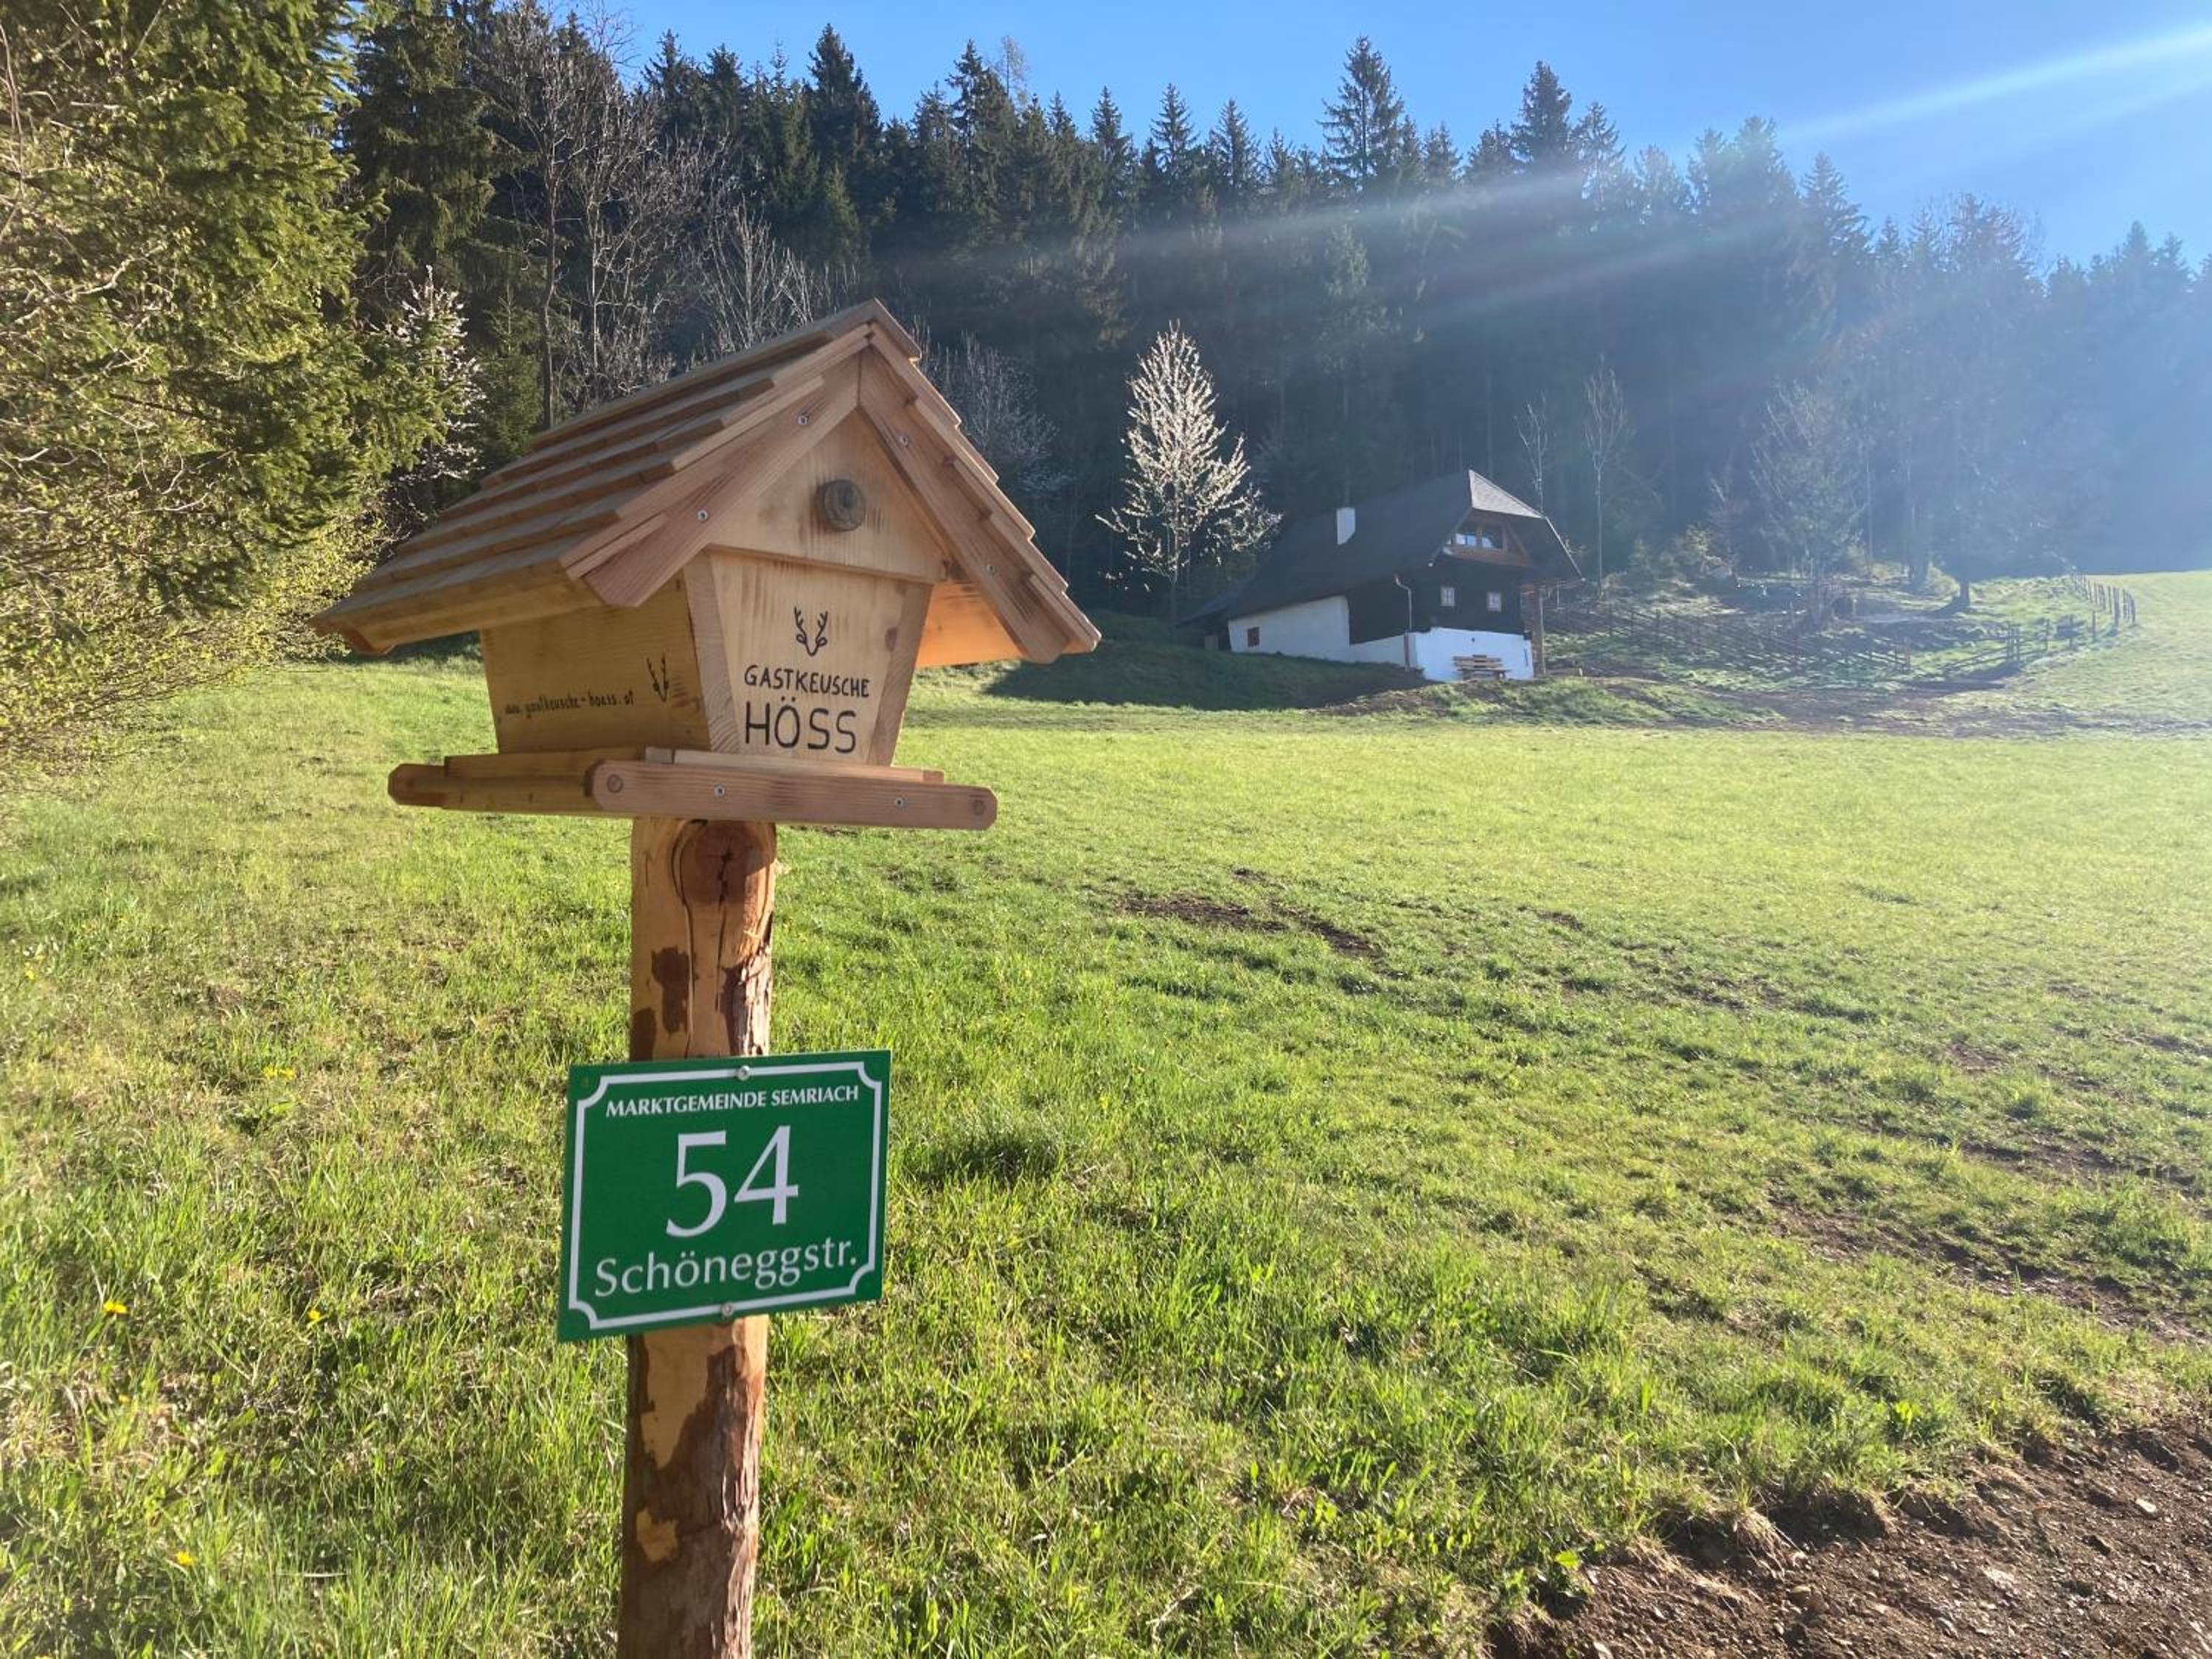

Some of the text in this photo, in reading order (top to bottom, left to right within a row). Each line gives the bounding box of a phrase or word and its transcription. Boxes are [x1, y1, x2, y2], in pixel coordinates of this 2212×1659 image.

[744, 664, 870, 698] GASTKEUSCHE
[745, 696, 857, 754] HÖSS
[607, 1085, 859, 1117] MARKTGEMEINDE SEMRIACH
[667, 1125, 799, 1237] 54
[595, 1237, 857, 1297] Schöneggstr.
